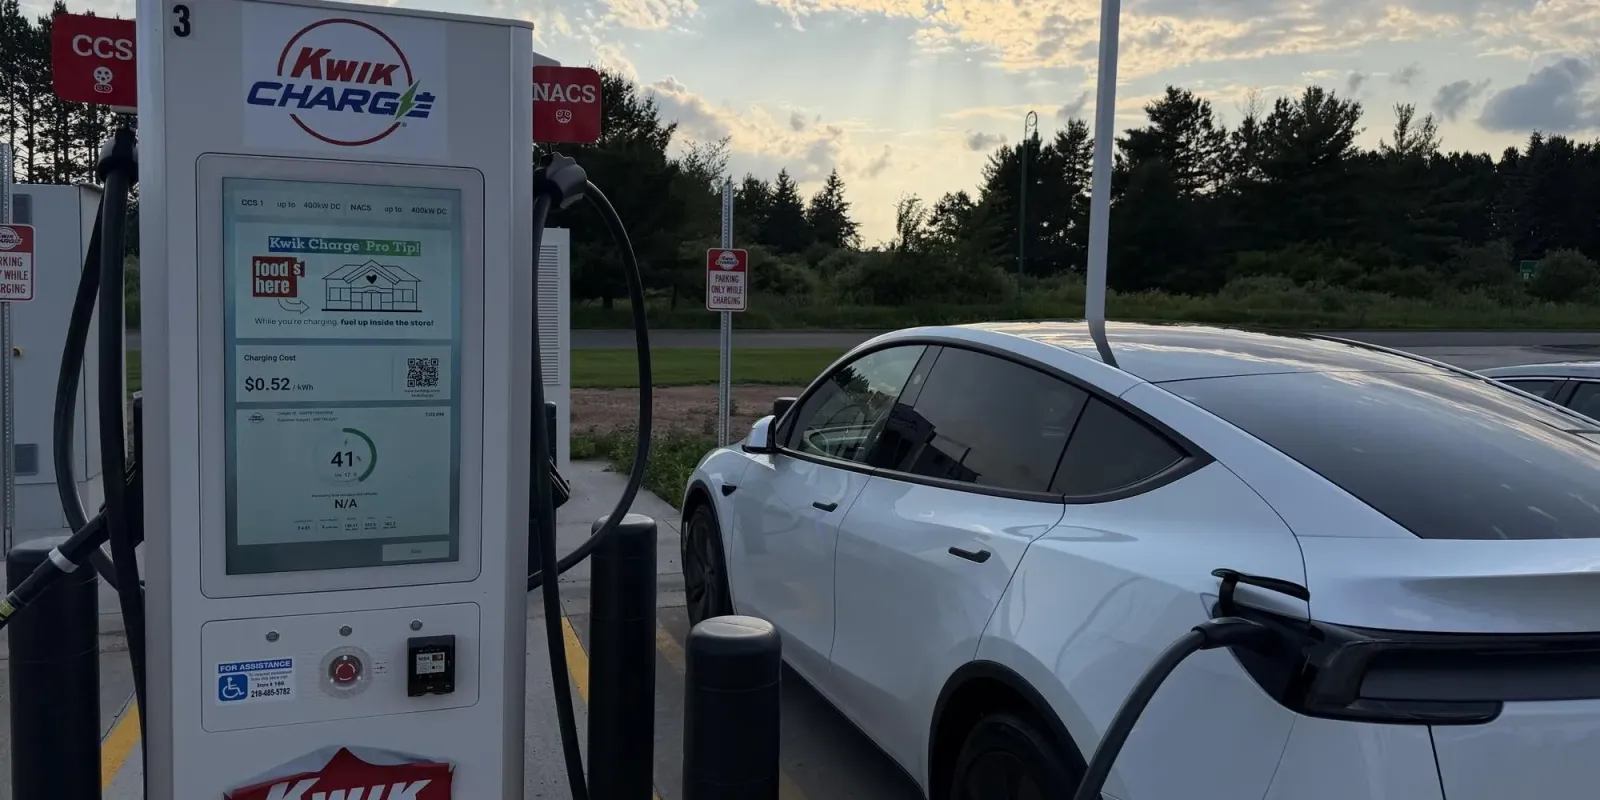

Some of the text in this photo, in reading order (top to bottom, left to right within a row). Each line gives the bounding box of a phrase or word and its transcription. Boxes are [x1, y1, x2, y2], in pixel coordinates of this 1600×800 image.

[173, 4, 191, 38] 3
[72, 34, 133, 61] CCS
[532, 82, 596, 103] NACS
[247, 81, 436, 119] CHARGE
[241, 199, 258, 207] CCS
[277, 201, 285, 209] up
[303, 202, 329, 210] 400kW
[350, 204, 372, 212] NACS
[269, 236, 421, 255] Kwik Charge Pro Tip!
[4, 270, 28, 281] WHILE
[715, 274, 739, 283] PARKING
[0, 283, 26, 294] RGING
[255, 277, 290, 293] here
[711, 285, 742, 294] ONLY WHILE
[712, 296, 741, 305] CHARGING
[254, 317, 276, 325] While
[278, 318, 301, 327] you're
[340, 318, 357, 326] fuel
[358, 319, 368, 328] up
[370, 318, 393, 327] inside
[394, 319, 408, 327] the
[410, 319, 434, 327] store!
[244, 354, 296, 363] Charging Cost
[244, 376, 291, 392] $0.52
[297, 383, 314, 391] kWh
[330, 450, 353, 468] 41
[334, 499, 358, 509] N/A
[220, 660, 291, 672] FOR ASSISTANCE
